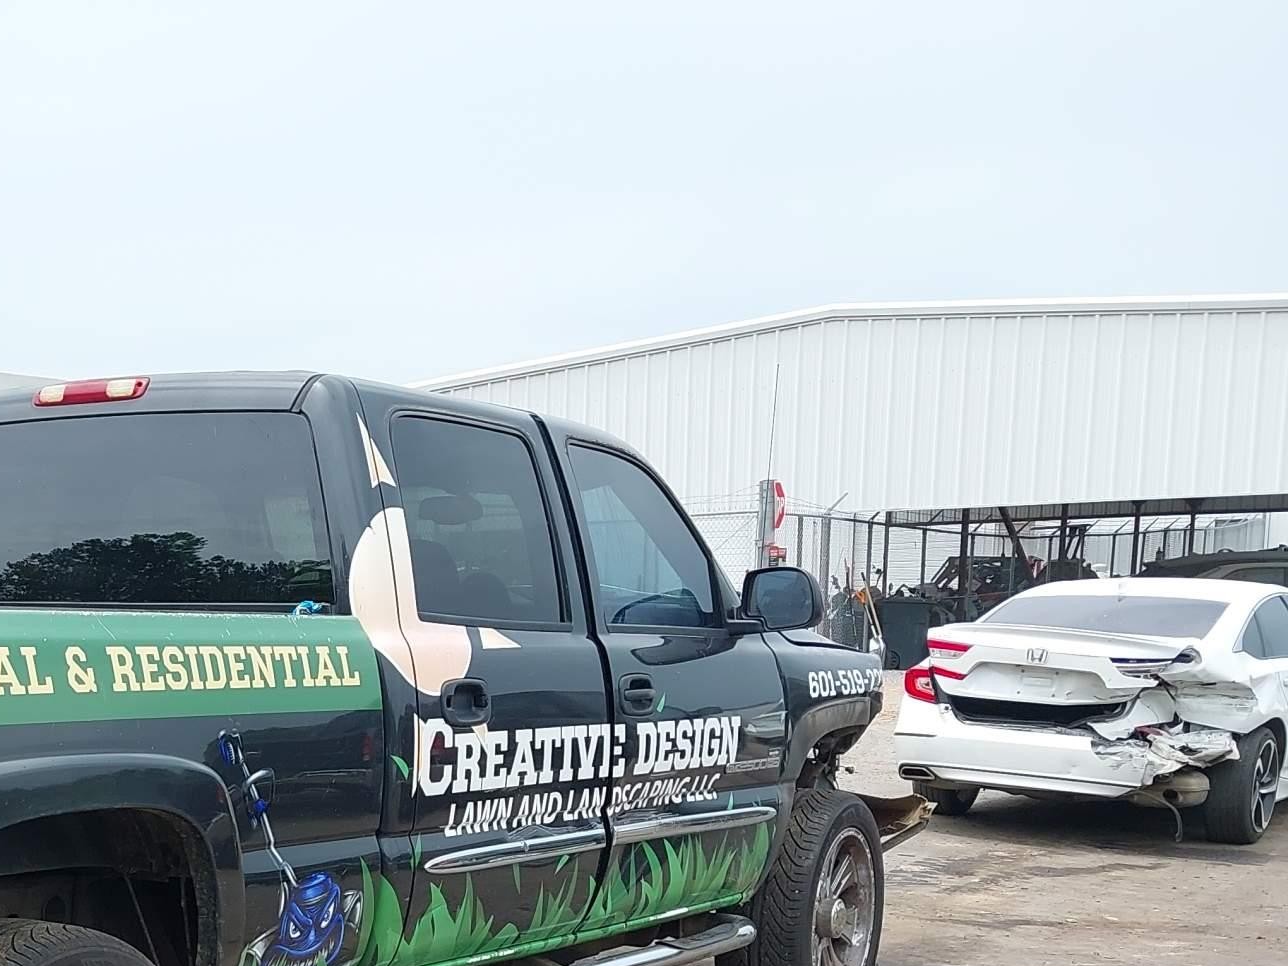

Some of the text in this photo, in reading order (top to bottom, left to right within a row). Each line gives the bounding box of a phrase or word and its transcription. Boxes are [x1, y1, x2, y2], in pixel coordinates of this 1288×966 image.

[65, 646, 98, 693] &
[105, 646, 361, 692] RESIDENTIAL
[418, 716, 741, 797] CREATIVE DESIGN
[444, 797, 514, 837] LAWN
[512, 791, 562, 828] AND
[562, 776, 690, 822] LANDSCAPING
